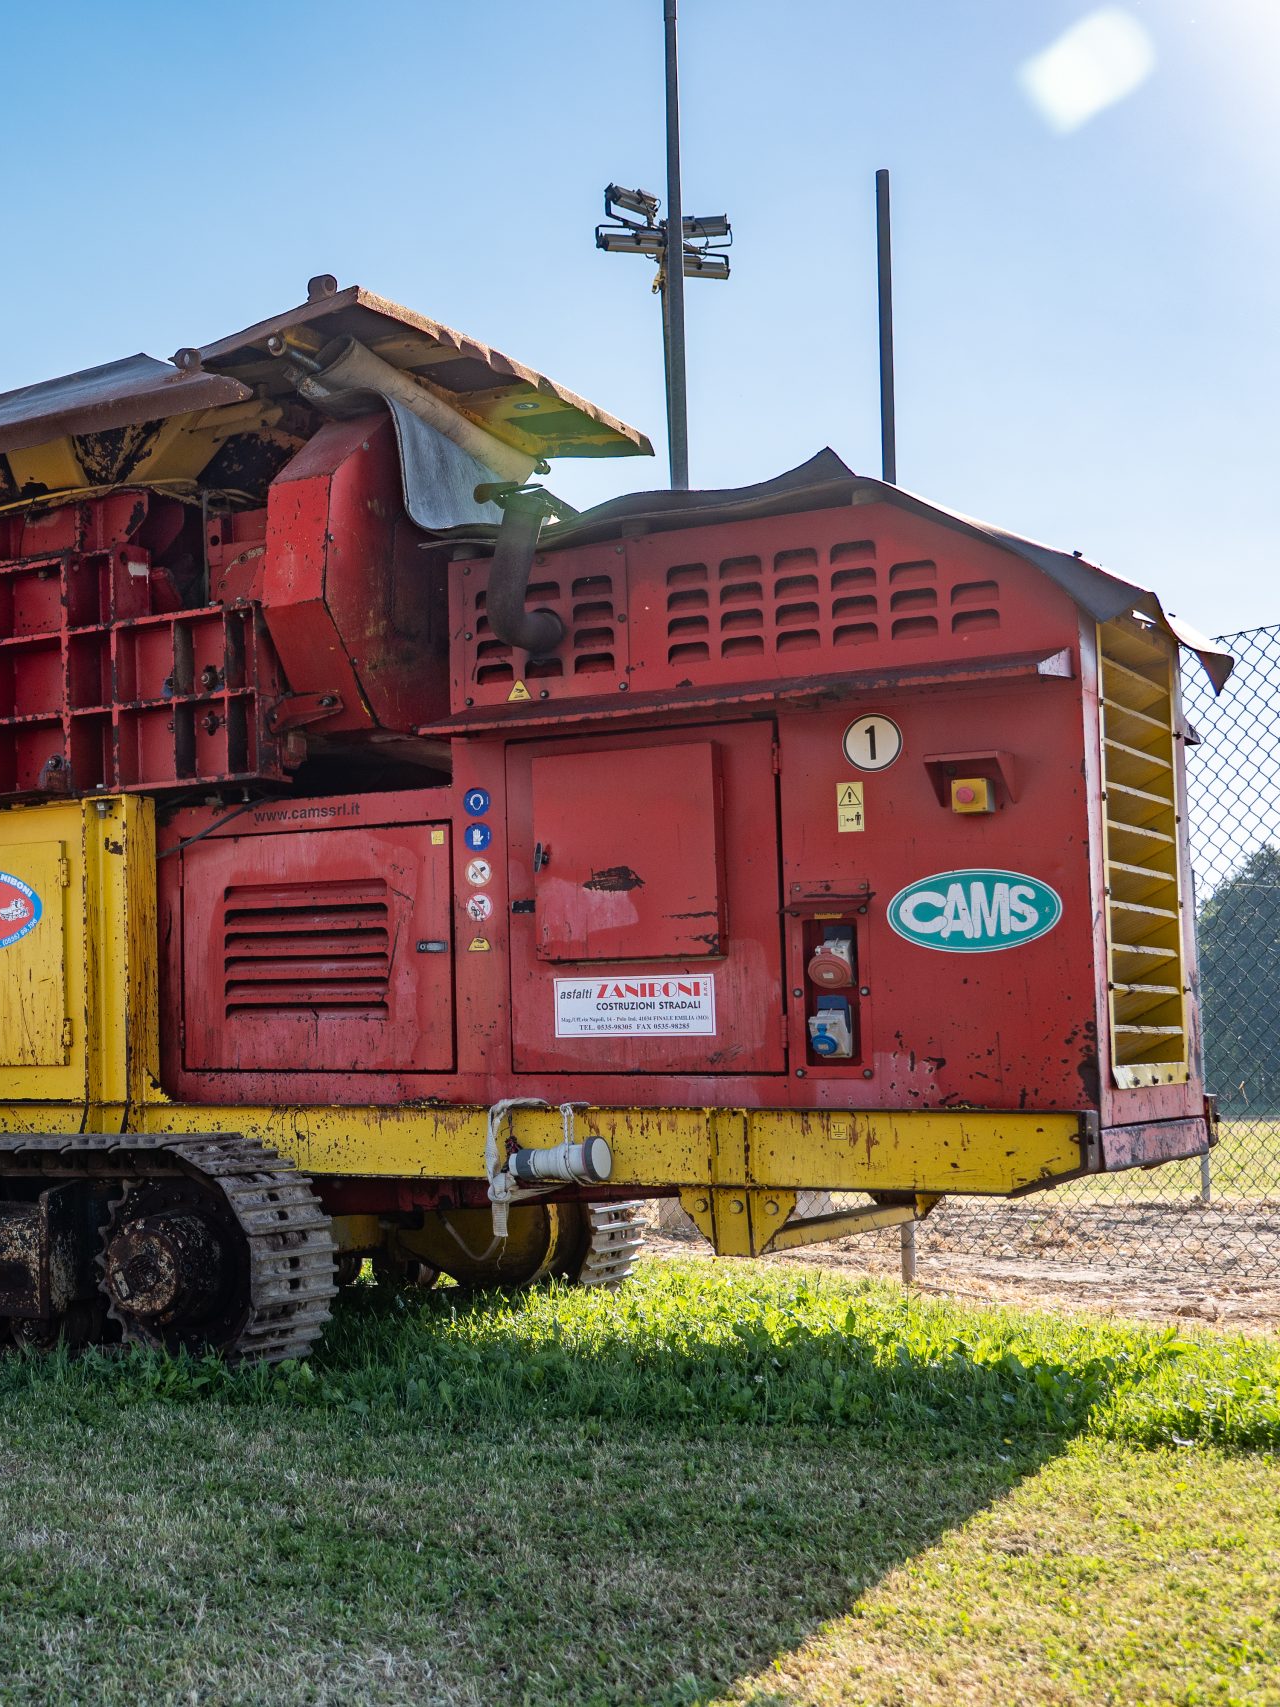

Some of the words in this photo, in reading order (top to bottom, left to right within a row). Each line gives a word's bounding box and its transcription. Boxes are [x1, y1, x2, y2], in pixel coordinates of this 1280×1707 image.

[864, 725, 877, 760] 1
[254, 802, 360, 822] www.camssrl.it
[899, 881, 1040, 939] CAMS
[560, 988, 592, 1000] asfalti
[596, 981, 701, 999] ZANIBONI
[596, 1001, 656, 1011] COSTRUZIONI
[659, 1000, 701, 1010] STRADALI
